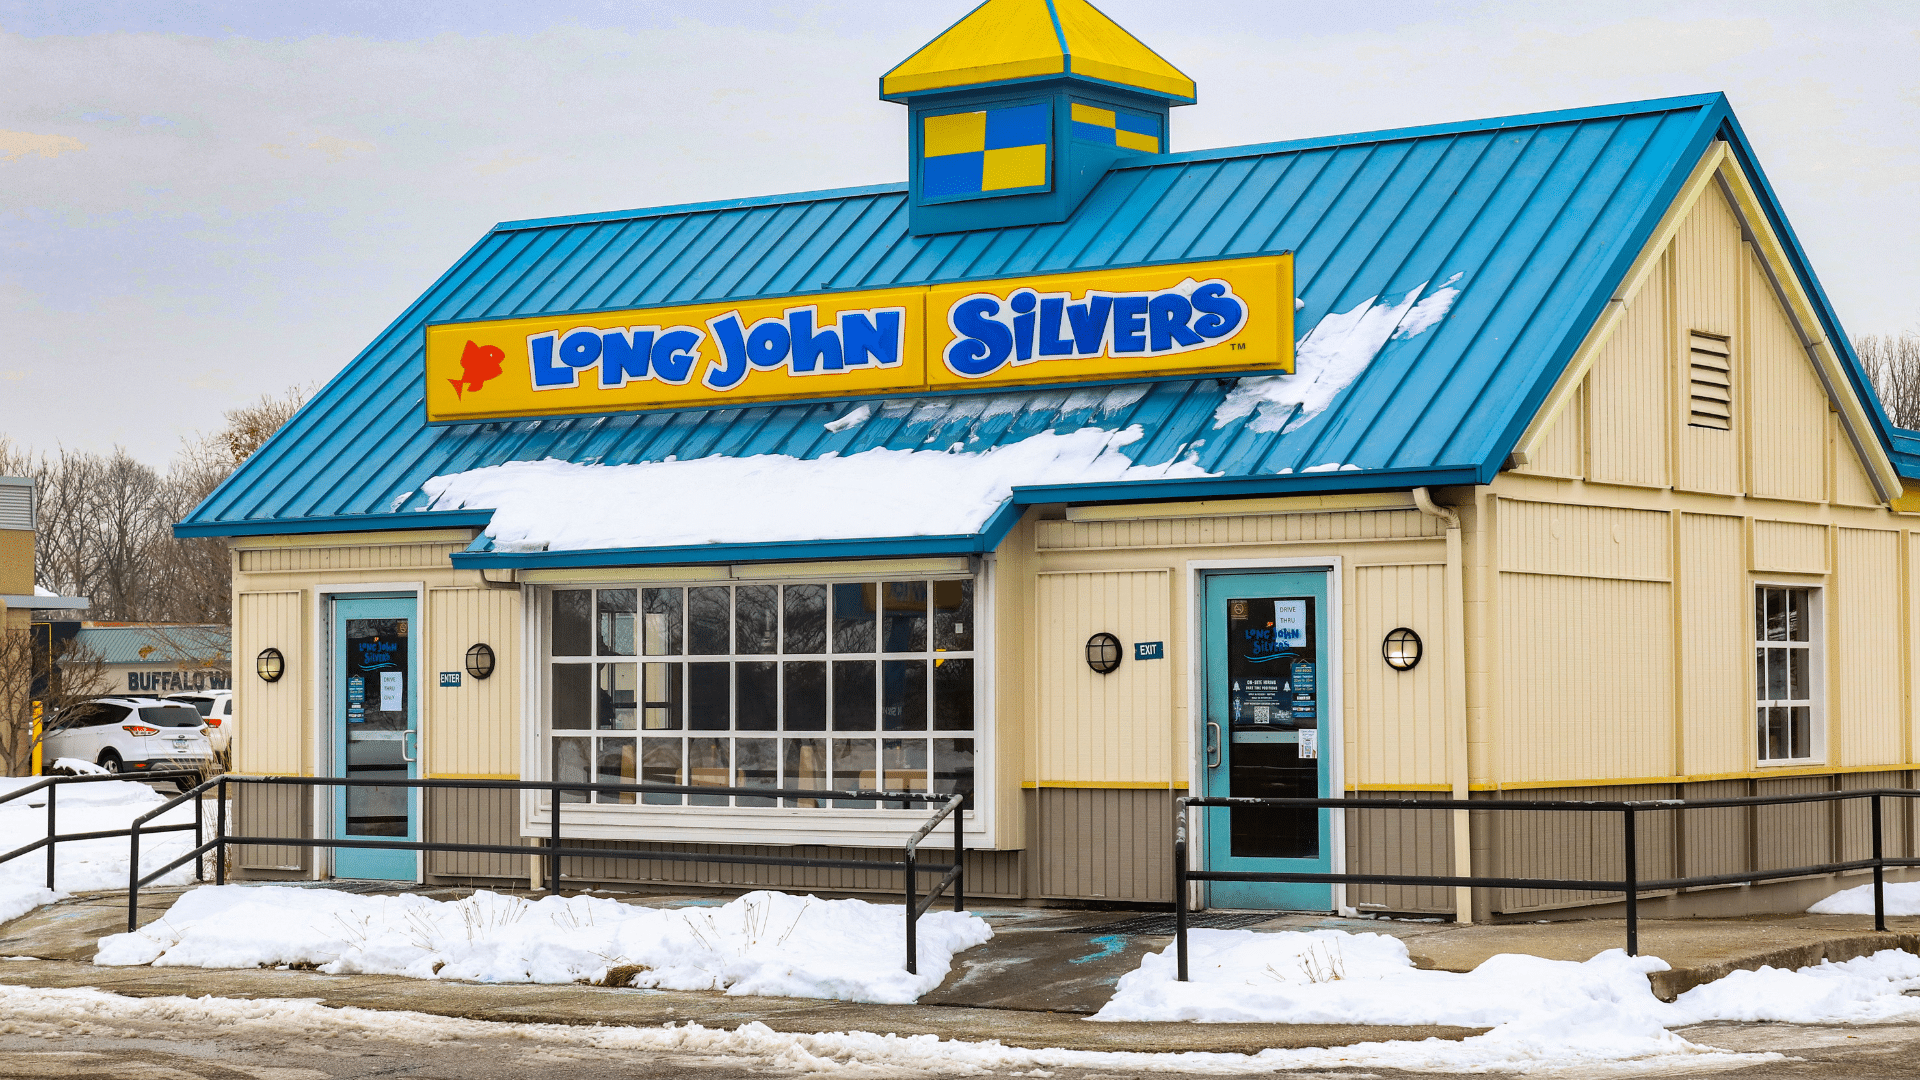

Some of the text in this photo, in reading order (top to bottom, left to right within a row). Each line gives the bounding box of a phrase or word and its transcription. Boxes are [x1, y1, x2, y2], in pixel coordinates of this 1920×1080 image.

[1140, 644, 1157, 656] EXIT
[128, 671, 204, 691] BUFFALO
[440, 673, 460, 683] ENTER
